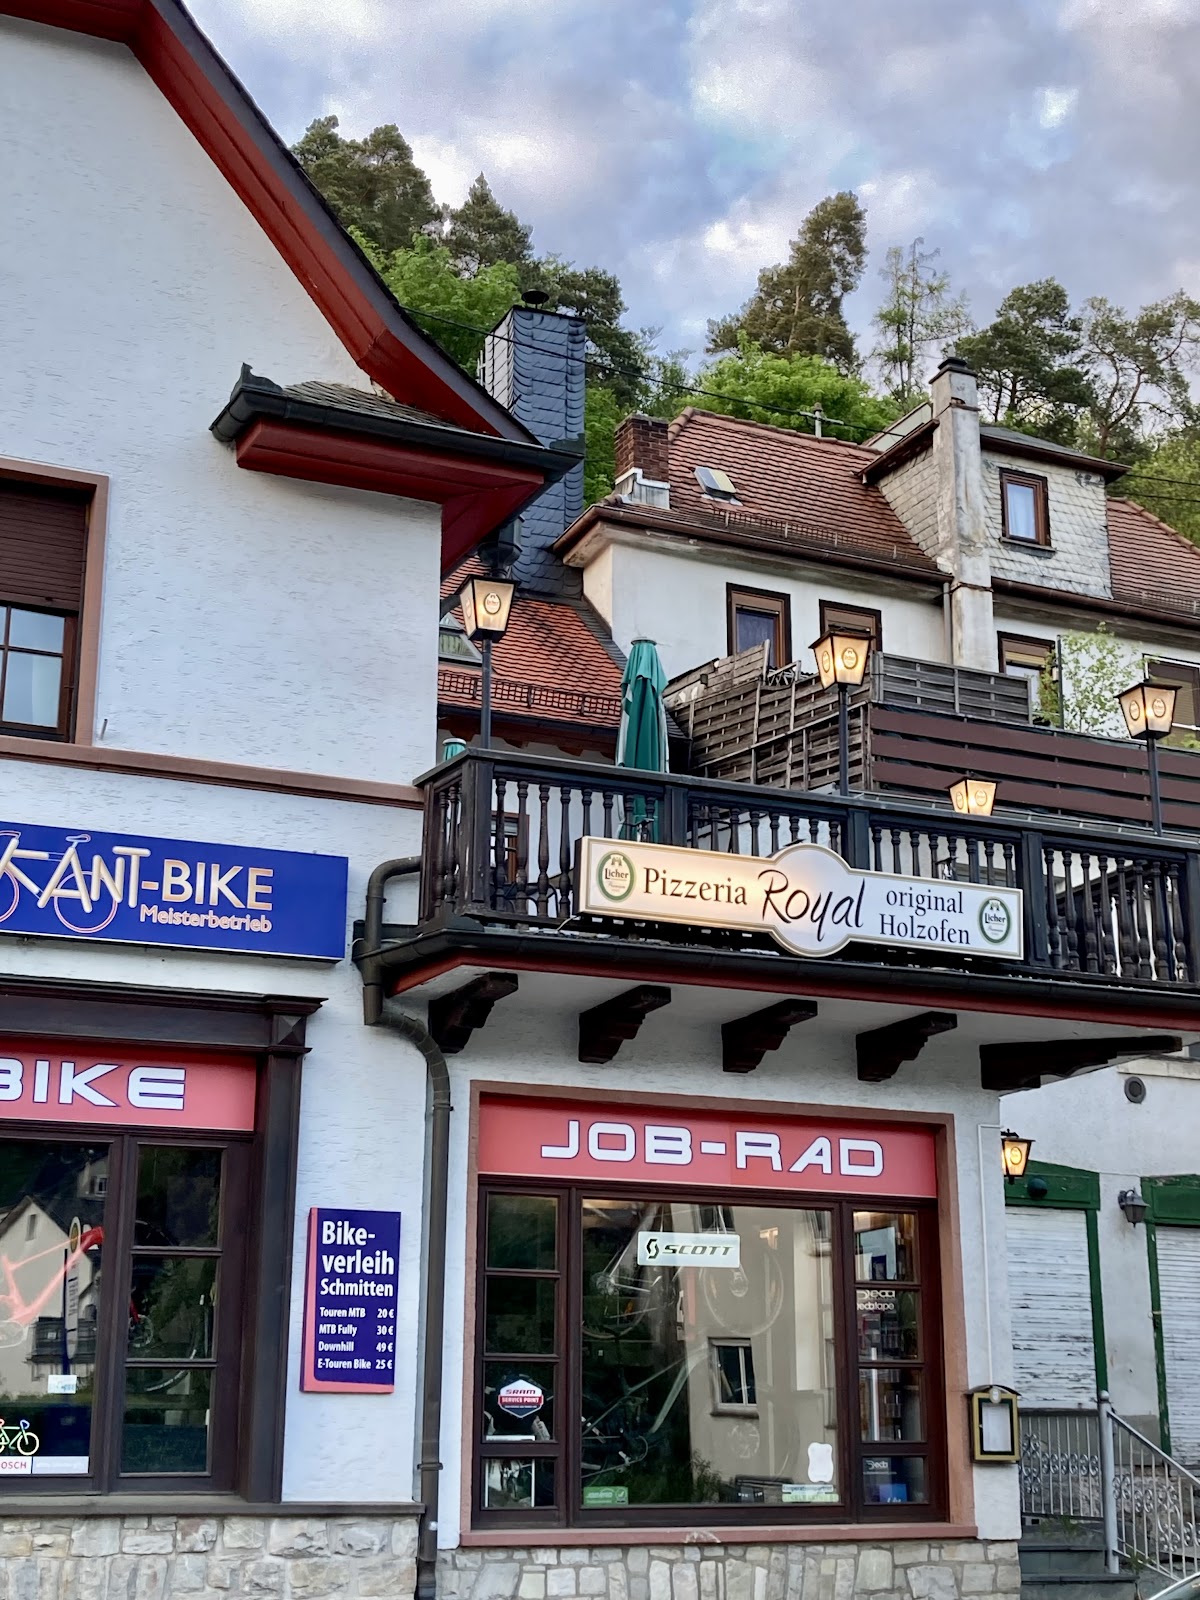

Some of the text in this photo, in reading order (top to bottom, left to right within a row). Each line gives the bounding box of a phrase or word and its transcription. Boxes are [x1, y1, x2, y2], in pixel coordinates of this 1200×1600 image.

[604, 867, 629, 880] Licher
[643, 866, 748, 906] Pizzeria
[757, 869, 865, 942] Royal
[886, 886, 964, 917] original
[140, 903, 273, 933] Meisterbetrieb
[984, 912, 1006, 924] Licher
[879, 913, 971, 945] Holzofen
[541, 1120, 884, 1177] JOB-RAD
[322, 1220, 376, 1246] Bike-
[662, 1244, 734, 1256] SCOTT
[321, 1249, 394, 1275] verleih
[320, 1278, 394, 1297] Schmitten
[320, 1307, 394, 1318] Touren MTB 20 €
[319, 1324, 394, 1337] MTB Fully 30 €
[318, 1341, 393, 1352] Downhill 49 €
[317, 1358, 393, 1369] E-Touren Bike 25 €
[0, 1461, 27, 1469] OSCH
